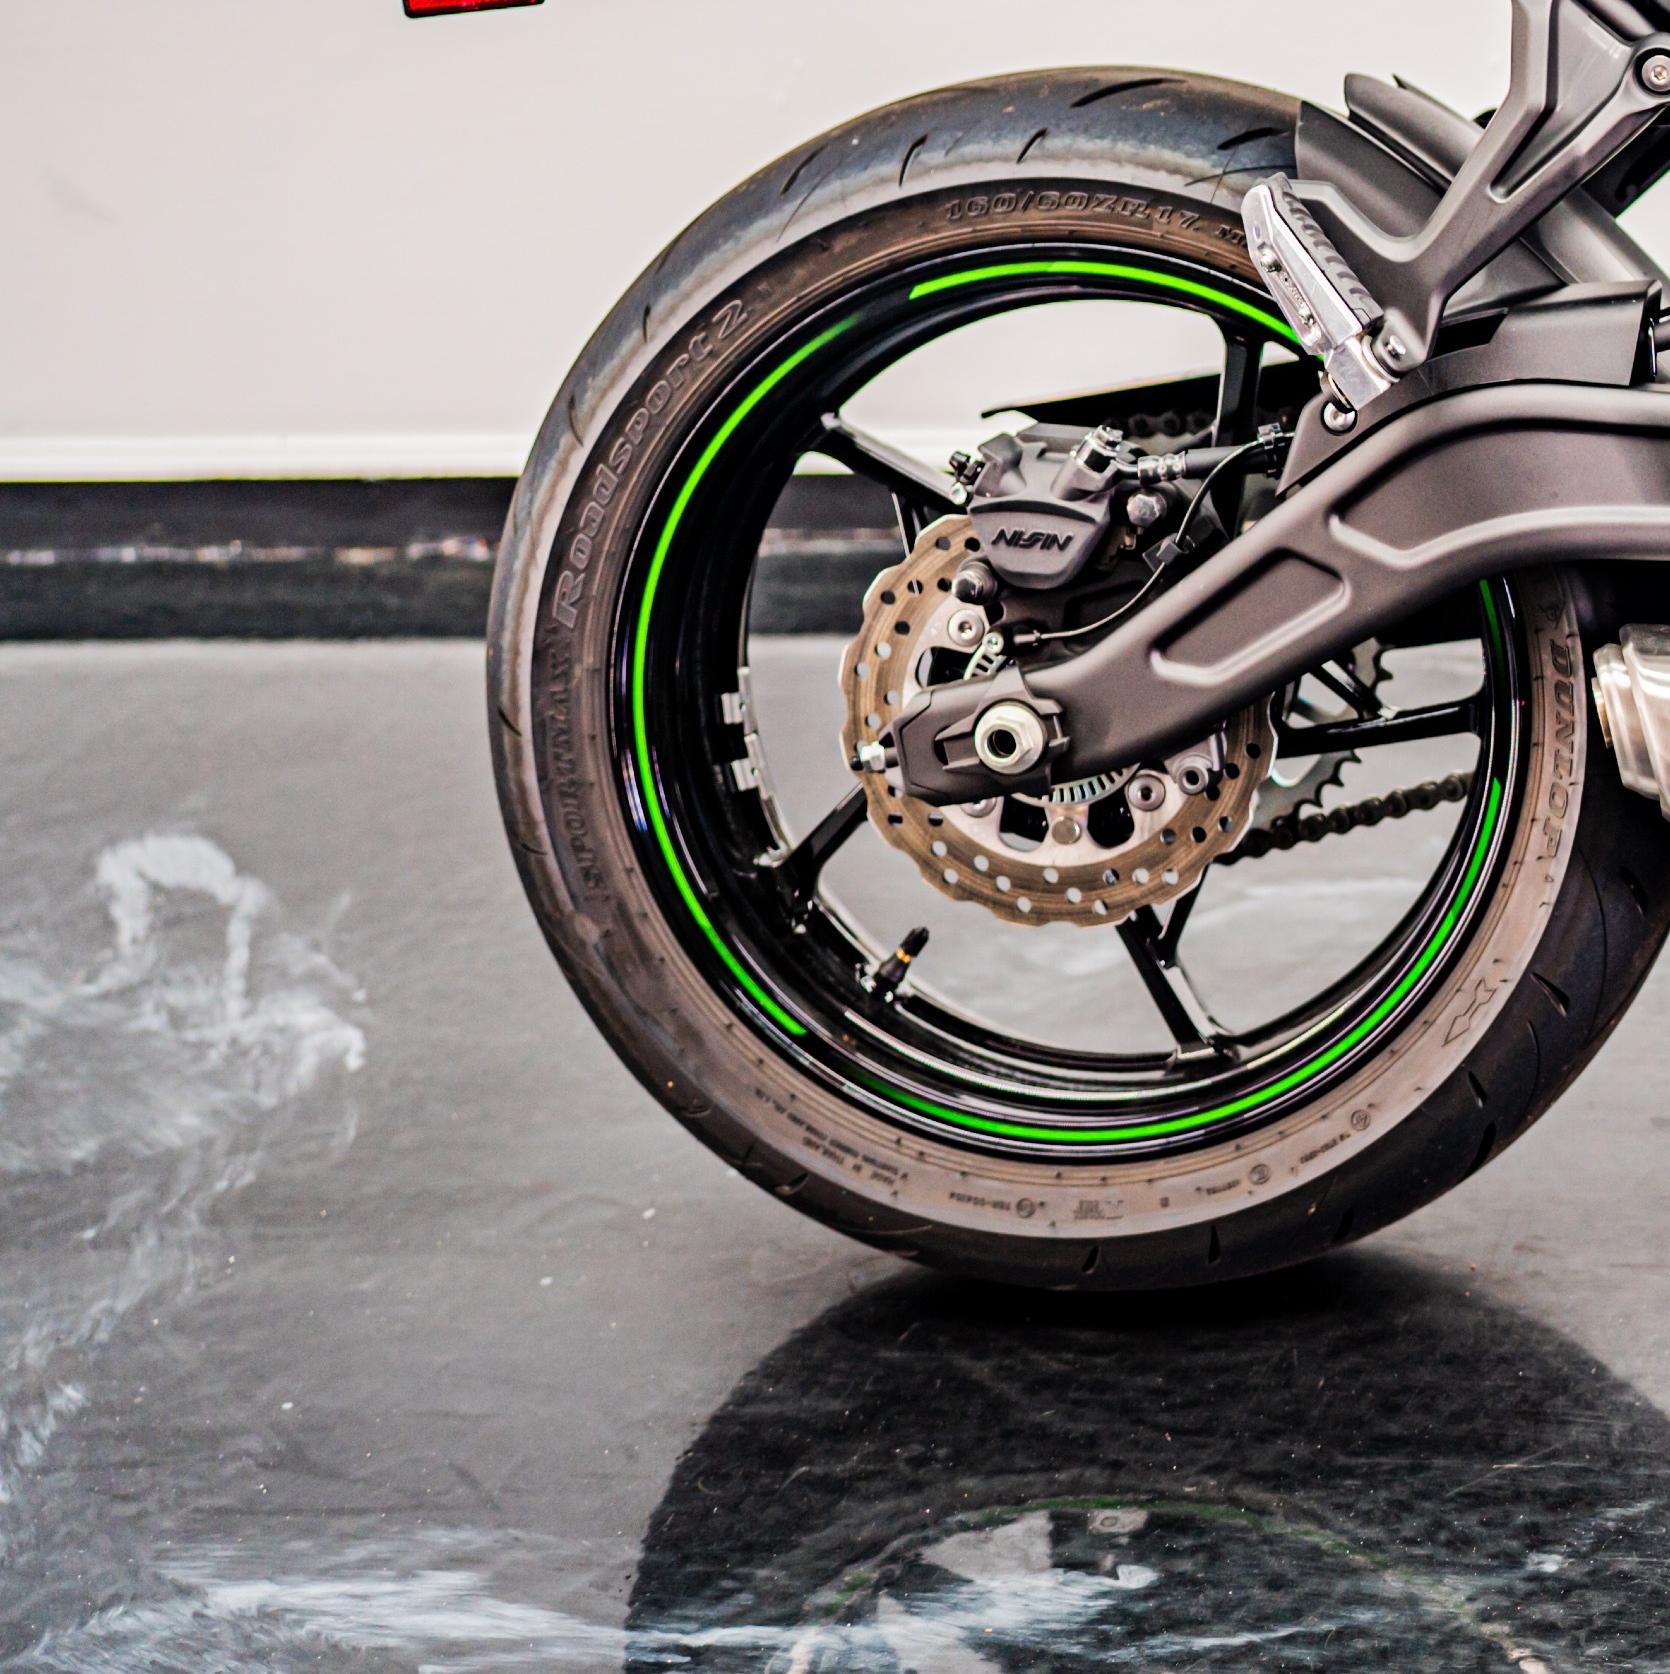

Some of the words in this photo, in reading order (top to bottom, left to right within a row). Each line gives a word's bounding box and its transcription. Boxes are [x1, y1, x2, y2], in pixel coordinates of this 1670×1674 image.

[940, 186, 1203, 232] 160/60ZR17
[549, 328, 717, 630] Roadsport
[1535, 639, 1574, 860] DUNLOP
